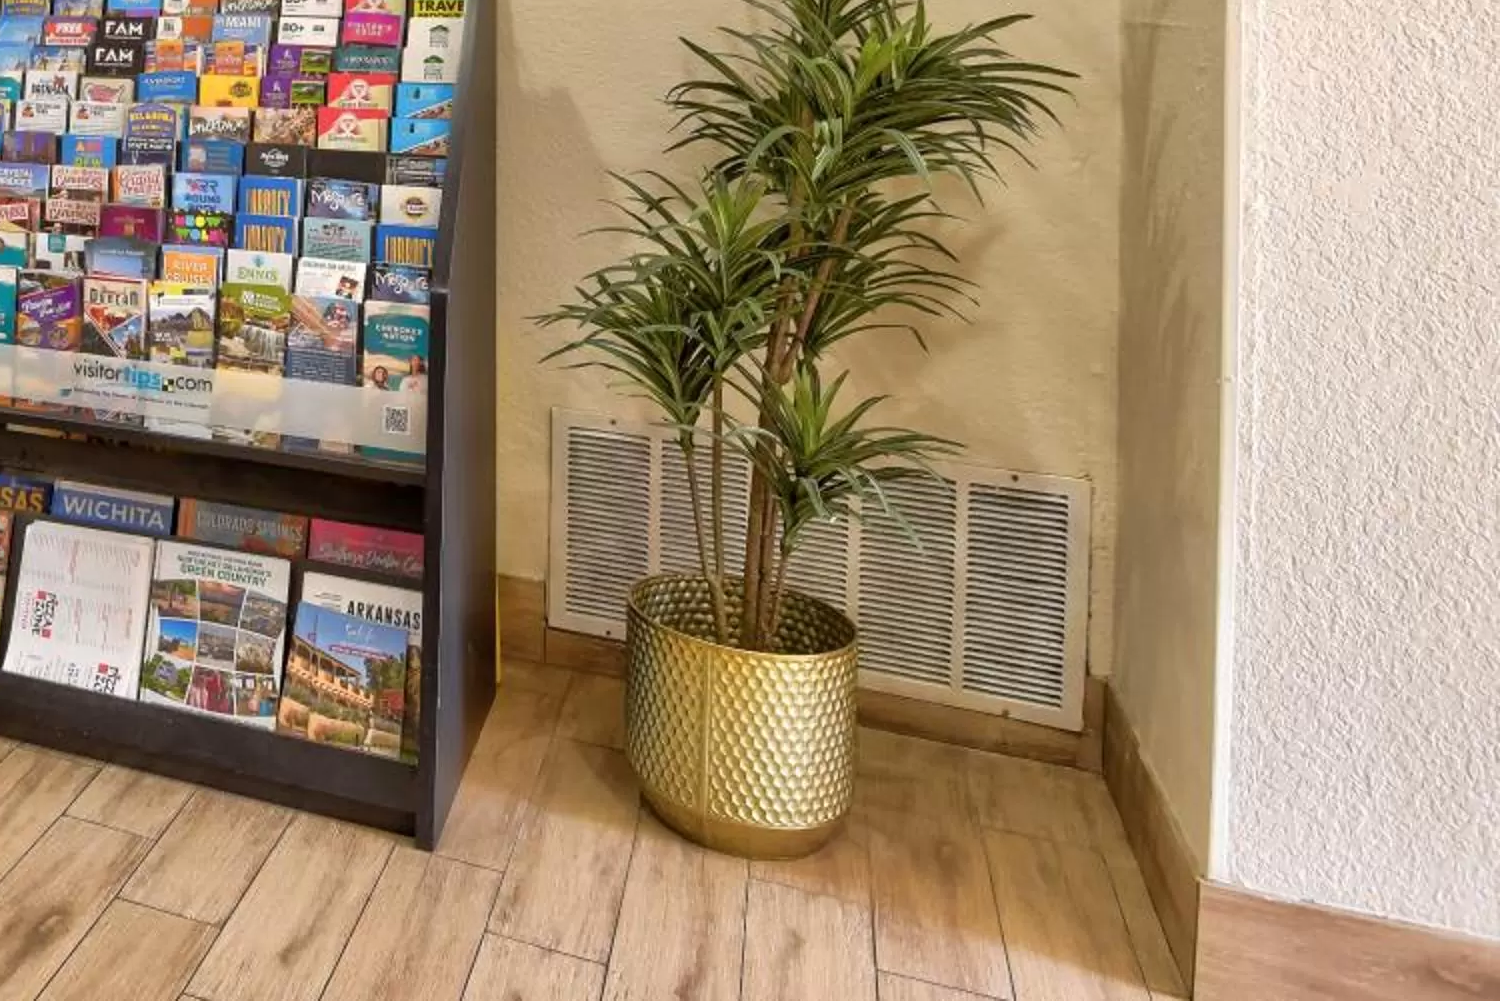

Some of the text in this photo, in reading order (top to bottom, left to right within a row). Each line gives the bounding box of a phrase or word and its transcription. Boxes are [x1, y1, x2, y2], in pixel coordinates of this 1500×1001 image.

[63, 495, 165, 529] WICHITA
[217, 570, 267, 587] COUNTRY
[348, 600, 421, 630] ARKANSAS
